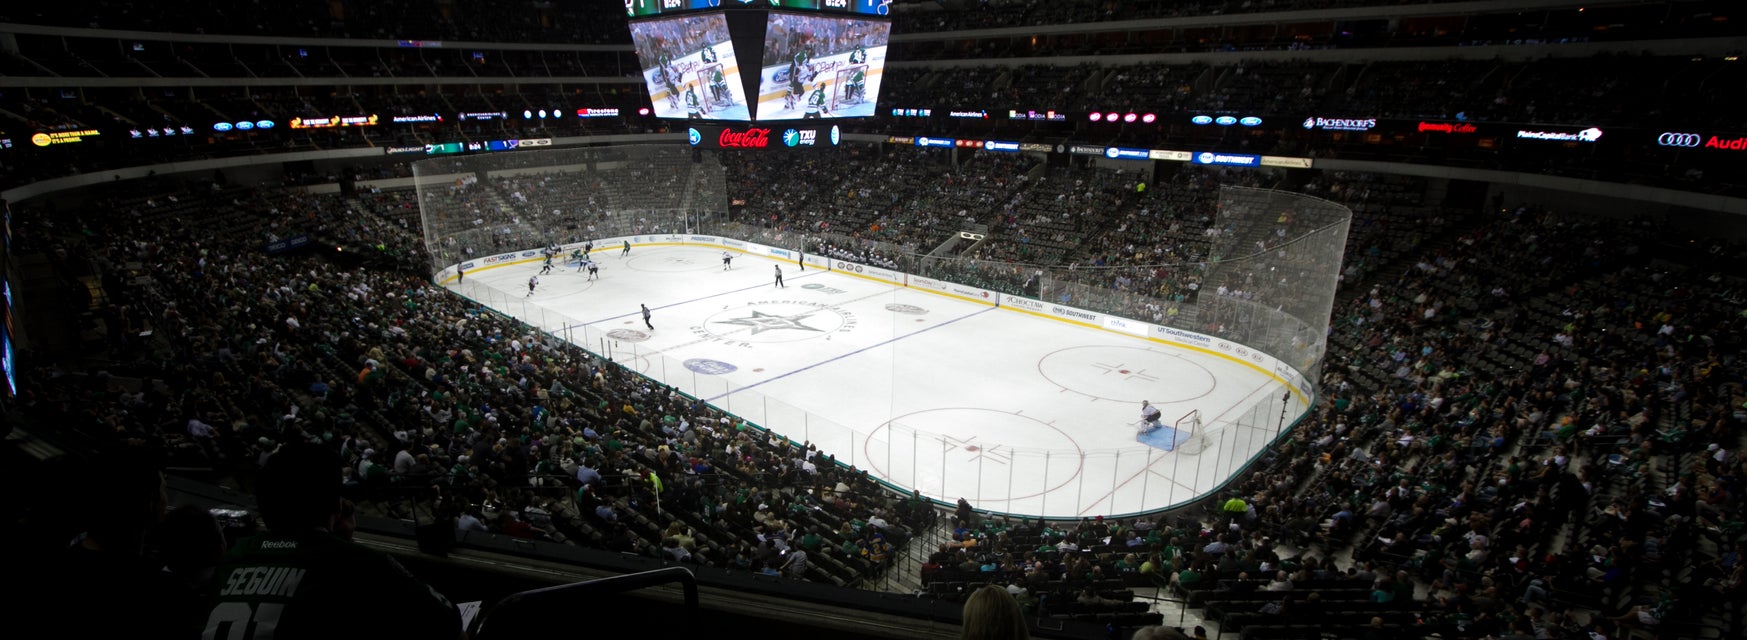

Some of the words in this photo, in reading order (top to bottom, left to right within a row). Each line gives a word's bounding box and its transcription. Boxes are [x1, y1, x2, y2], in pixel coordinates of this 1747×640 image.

[719, 127, 772, 148] Coca-Cola
[799, 129, 817, 141] TXU
[1704, 135, 1747, 150] Audi
[261, 540, 298, 549] Reebok
[220, 566, 306, 597] SEGUIN
